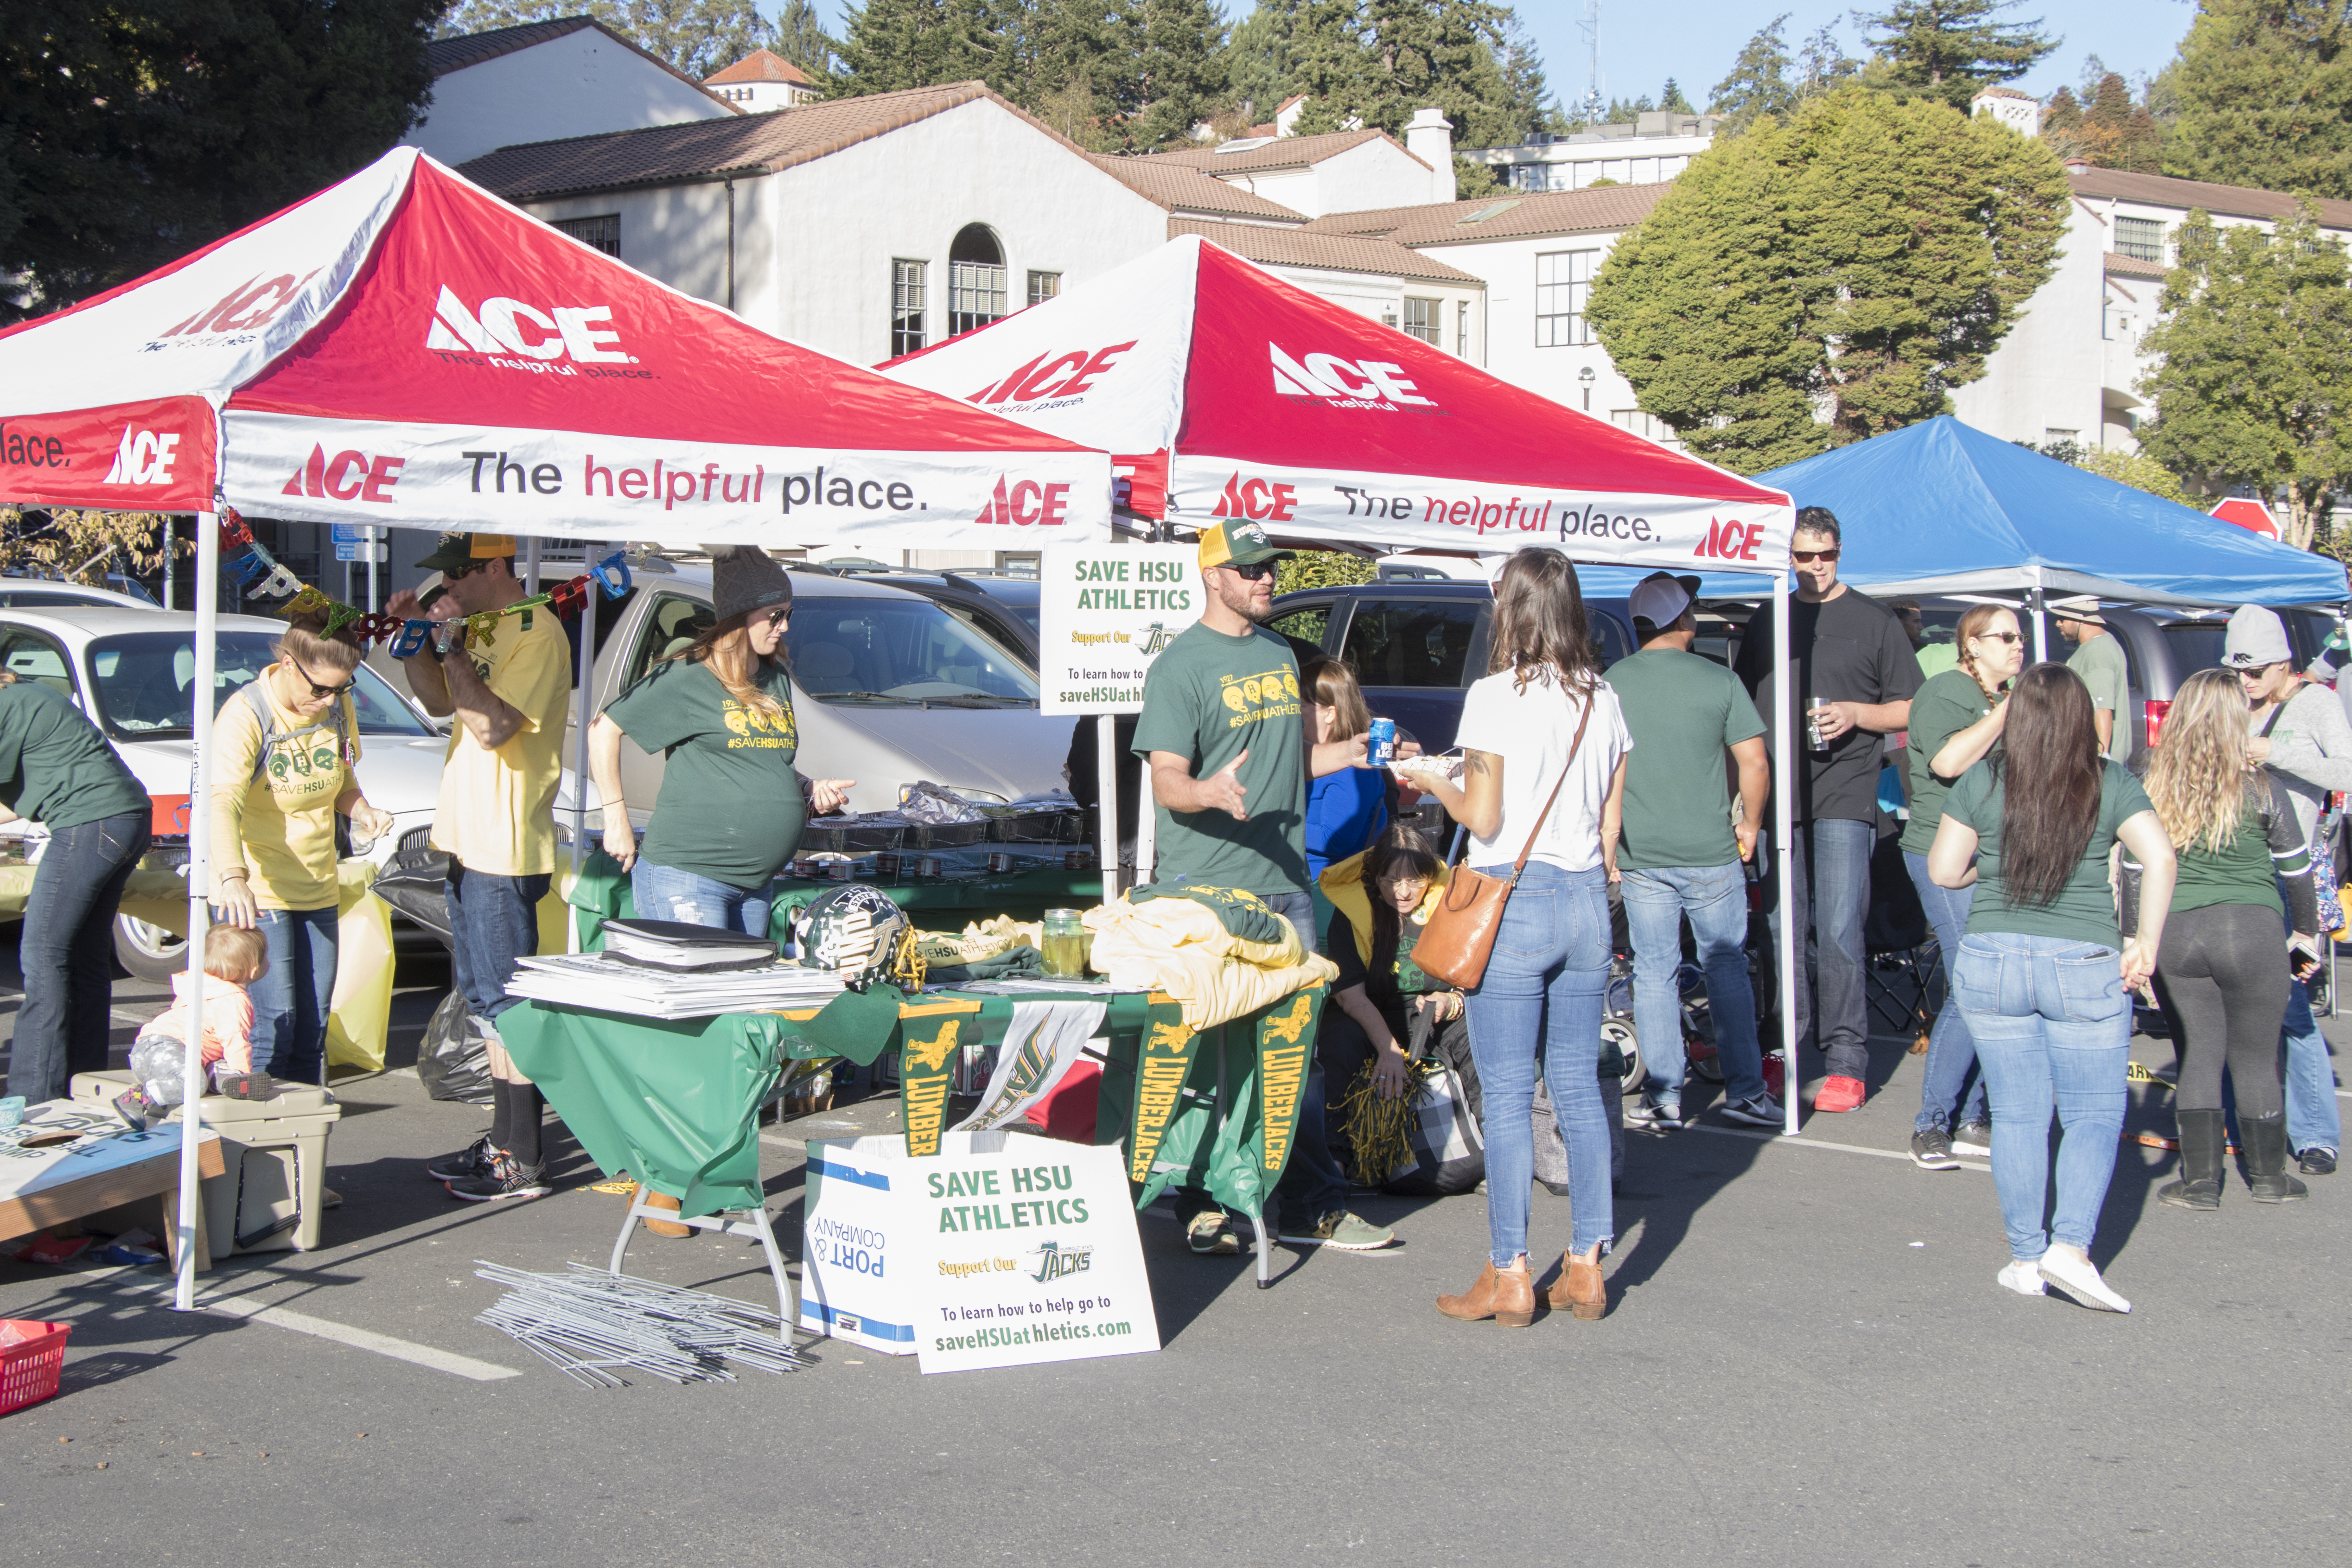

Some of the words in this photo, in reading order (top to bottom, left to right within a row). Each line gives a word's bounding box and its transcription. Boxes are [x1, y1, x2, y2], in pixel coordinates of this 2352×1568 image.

[426, 284, 630, 363] ACE
[433, 352, 484, 366] The
[488, 356, 578, 376] helpful
[583, 367, 661, 379] place.
[963, 339, 1139, 405] ACE
[1269, 341, 1432, 406] ACE
[1033, 396, 1084, 413] place.
[1283, 395, 1326, 407] The
[1326, 398, 1399, 412] helpful
[0, 422, 70, 468] lace.
[102, 423, 180, 485] ACE
[281, 441, 406, 503] ACE
[462, 452, 561, 494] The
[585, 454, 764, 510] helpful
[782, 465, 927, 514] place.
[975, 472, 1070, 526] ACE
[1211, 469, 1297, 521] ACE
[1334, 485, 1413, 520] The
[1423, 496, 1552, 535] helpful
[1561, 504, 1661, 542] place.
[1694, 515, 1765, 561] ACE
[1075, 560, 1129, 582] SAVE
[1139, 561, 1183, 583] HSU
[1077, 588, 1191, 611] ATHLETICS
[1072, 631, 1111, 646] Support
[1114, 630, 1131, 644] Our
[1135, 621, 1179, 656] JAC
[1068, 668, 1079, 679] To
[1083, 668, 1107, 679] learn
[1111, 668, 1130, 679] how
[1134, 669, 1143, 679] to
[1220, 674, 1234, 683] 1927
[1376, 749, 1392, 759] LIG
[1381, 742, 1393, 750] BU
[851, 892, 873, 907] STATE
[906, 1073, 948, 1157] LUMBER
[1132, 1057, 1188, 1183] LUMBERJACKS
[1263, 1045, 1306, 1171] LUMBERJACKS
[928, 1170, 1001, 1198] SAVE
[1011, 1165, 1072, 1193] HSU
[939, 1198, 1089, 1233] ATHLETICS
[814, 1217, 885, 1249] COMPANY
[815, 1237, 827, 1261] &
[830, 1243, 884, 1278] PORT
[938, 1258, 991, 1278] Support
[994, 1256, 1017, 1271] Our
[1024, 1240, 1094, 1284] JACKS
[941, 1307, 956, 1321] To
[961, 1307, 994, 1320] learn
[998, 1303, 1024, 1317] how
[1029, 1302, 1042, 1314] to
[1046, 1298, 1074, 1314] help
[1078, 1299, 1093, 1314] go
[1098, 1296, 1111, 1308] to
